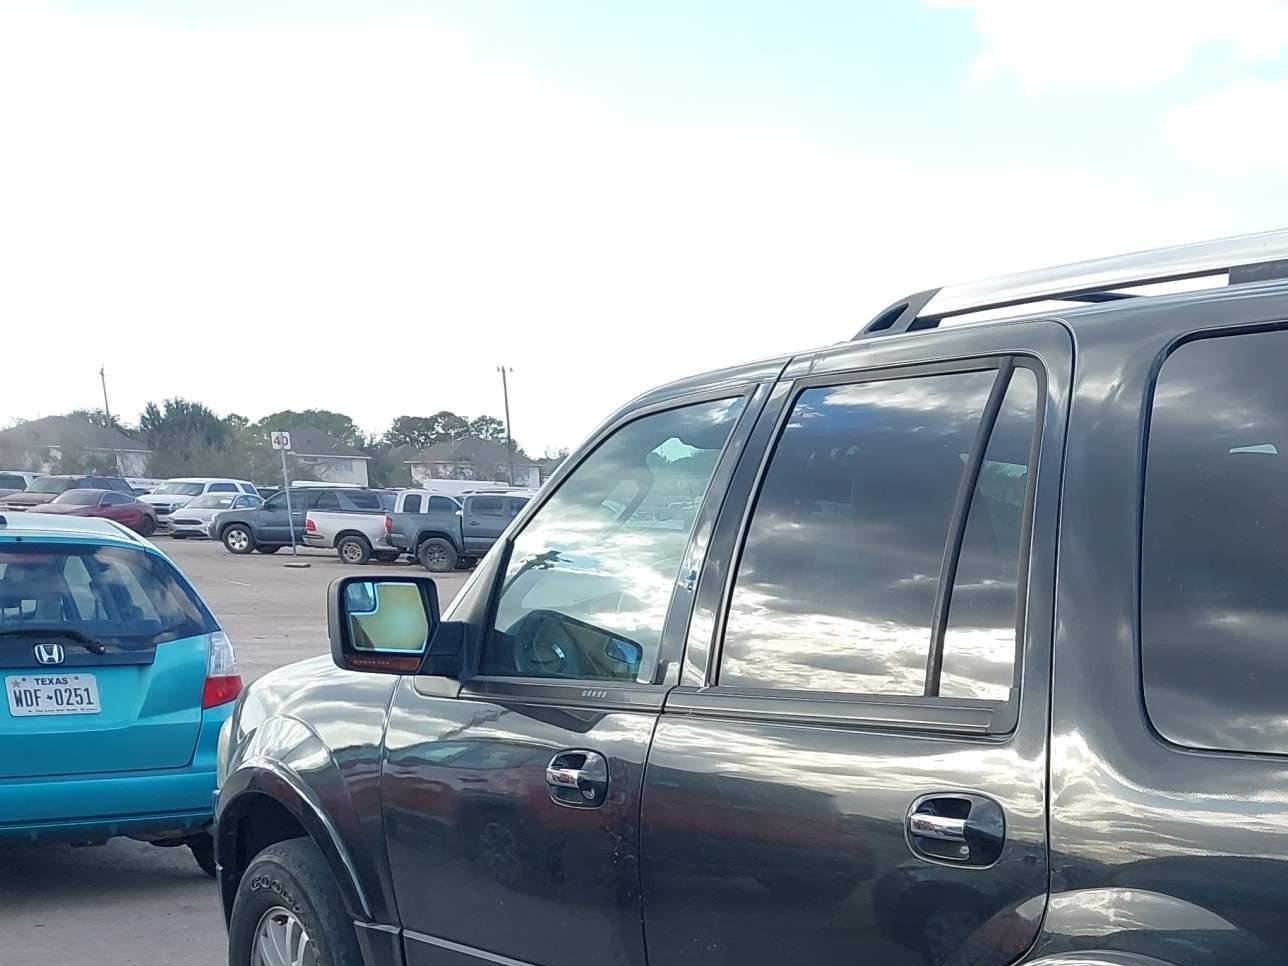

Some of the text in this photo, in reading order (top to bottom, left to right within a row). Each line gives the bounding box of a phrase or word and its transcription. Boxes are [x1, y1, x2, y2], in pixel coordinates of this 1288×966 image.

[33, 677, 69, 686] TEXAS
[13, 687, 94, 708] WDF 0251
